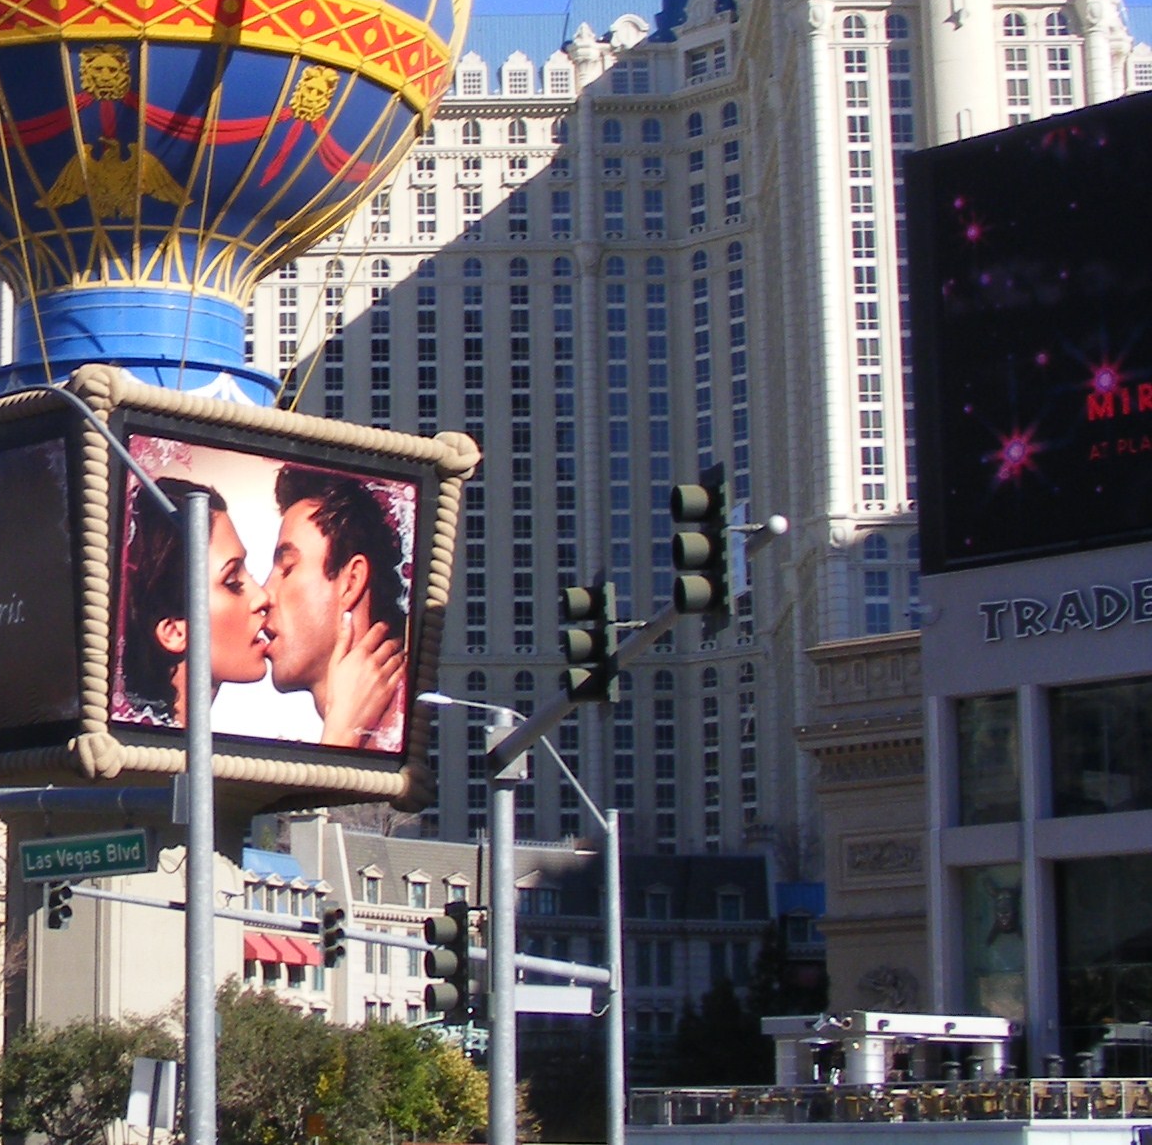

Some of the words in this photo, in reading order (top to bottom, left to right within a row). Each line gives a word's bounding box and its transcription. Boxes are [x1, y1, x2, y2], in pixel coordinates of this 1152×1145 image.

[26, 853, 53, 871] Las
[56, 848, 102, 871] Vegas
[105, 841, 141, 863] Blvd
